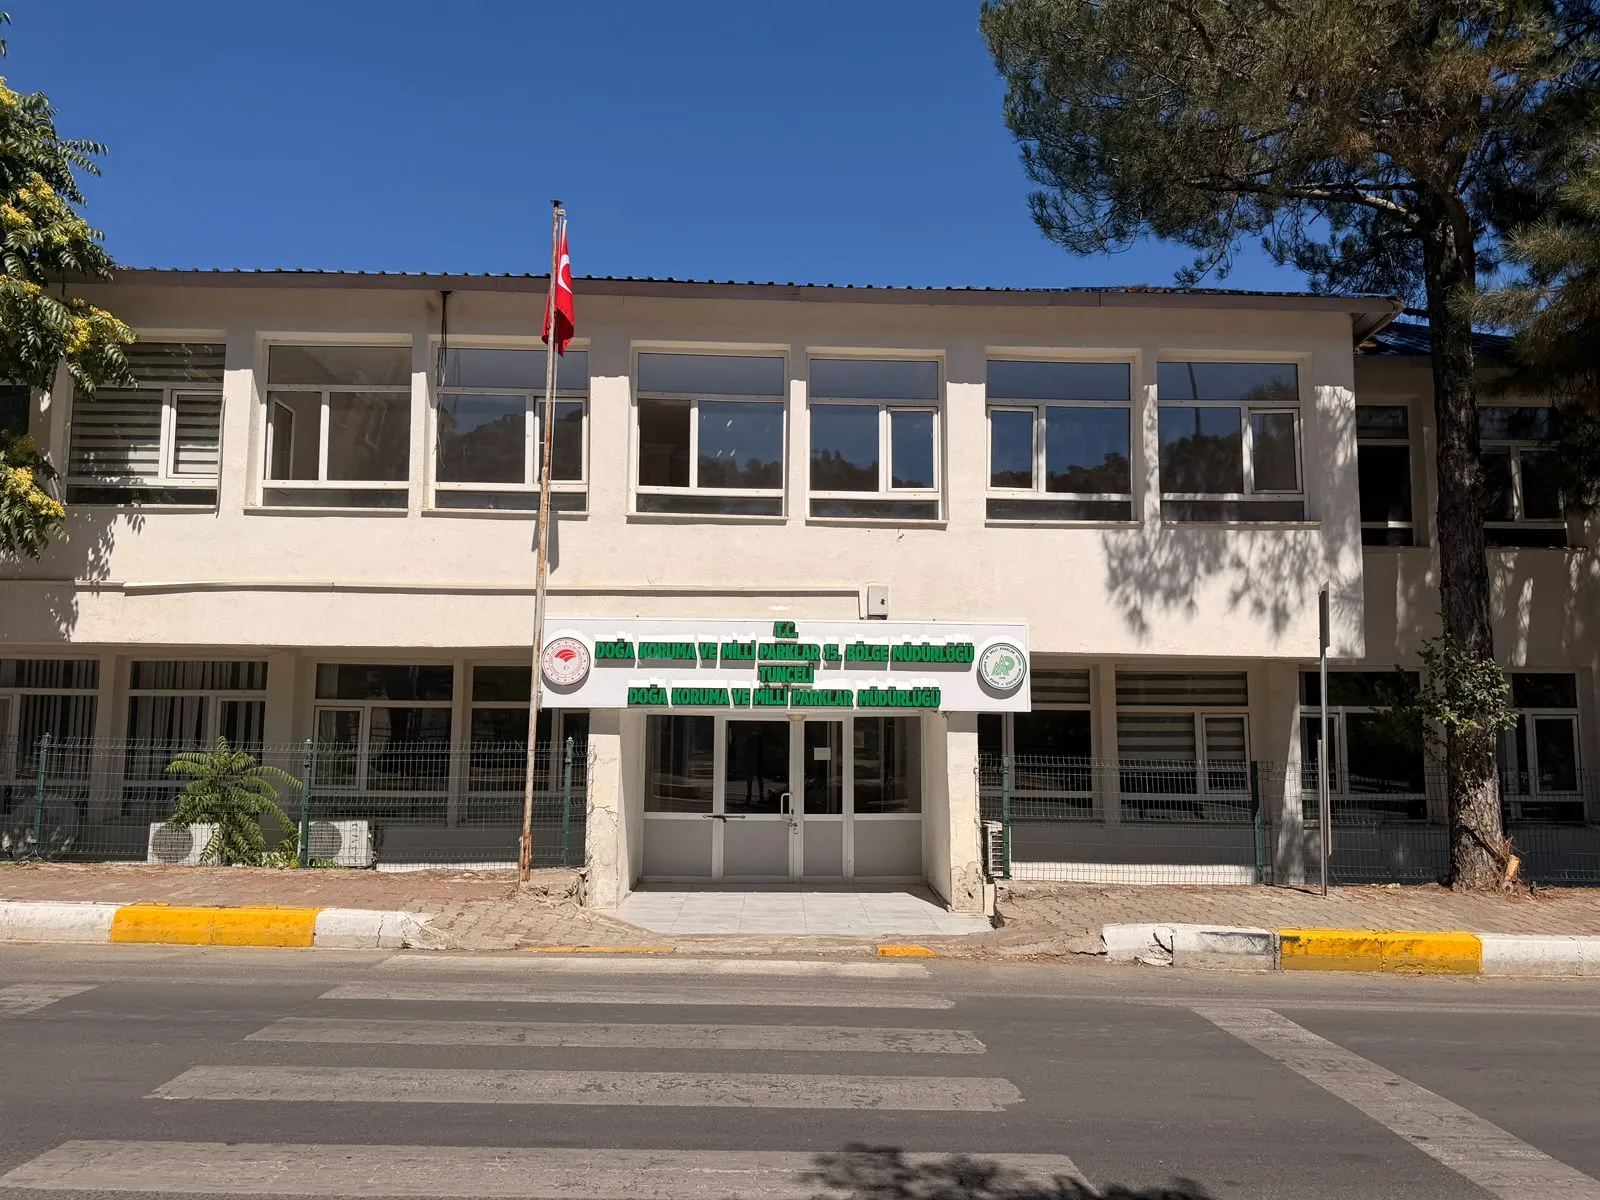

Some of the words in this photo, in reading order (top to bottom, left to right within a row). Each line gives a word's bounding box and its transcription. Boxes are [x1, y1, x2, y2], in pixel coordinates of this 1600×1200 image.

[774, 621, 799, 639] T.C.
[595, 639, 636, 660] DOĞA
[638, 642, 698, 660] KORUMA
[699, 642, 719, 660] VE
[720, 640, 757, 661] MİLLİ
[758, 643, 821, 661] PARKLAR
[823, 644, 843, 661] 15.
[845, 641, 889, 662] BÖLGE
[759, 664, 815, 684] TUNCELİ
[628, 684, 669, 705] DOĞA
[671, 687, 731, 706] KORUMA
[732, 687, 752, 706] VE
[753, 685, 789, 706] MİLLİ
[791, 689, 854, 707] PARKLAR
[857, 686, 942, 708] MÜDÜRLÜĞÜ
